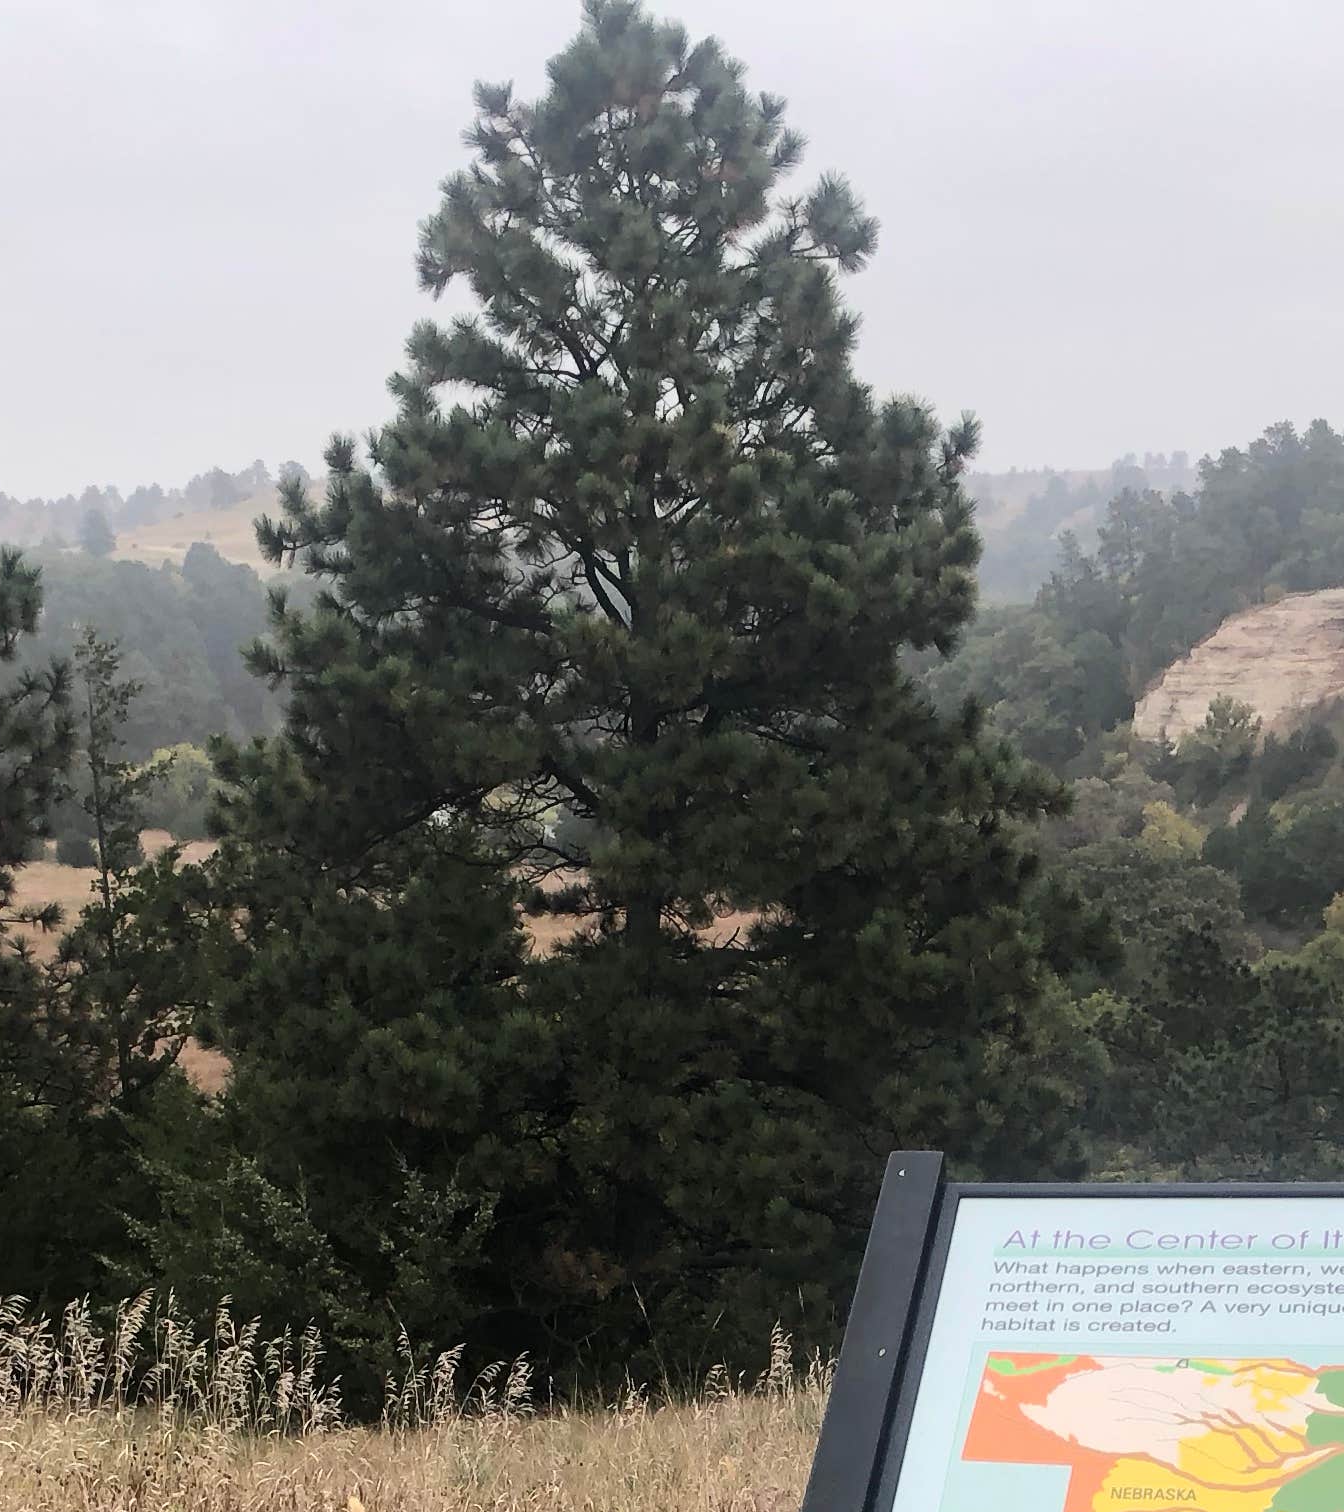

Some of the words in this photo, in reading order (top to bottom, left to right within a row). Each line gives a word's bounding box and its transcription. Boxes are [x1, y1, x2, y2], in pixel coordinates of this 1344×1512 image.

[1002, 1229, 1041, 1251] At
[1052, 1229, 1111, 1250] the
[1125, 1229, 1258, 1251] Center
[1271, 1229, 1310, 1251] of
[1319, 1229, 1343, 1250] It
[993, 1261, 1049, 1274] What
[1055, 1261, 1149, 1276] happens
[1156, 1261, 1215, 1275] when
[1222, 1262, 1311, 1277] eastern,
[988, 1280, 1085, 1295] northern,
[1093, 1280, 1135, 1294] and
[1141, 1280, 1239, 1294] southern
[984, 1299, 1040, 1312] meet
[1046, 1298, 1064, 1312] in
[1071, 1301, 1113, 1313] one
[1119, 1299, 1193, 1315] place?
[1199, 1299, 1217, 1313] A
[1223, 1302, 1271, 1316] very
[980, 1317, 1056, 1331] habitat
[1063, 1318, 1080, 1332] is
[1087, 1318, 1176, 1332] created.
[1110, 1486, 1197, 1501] NEBRASKA
